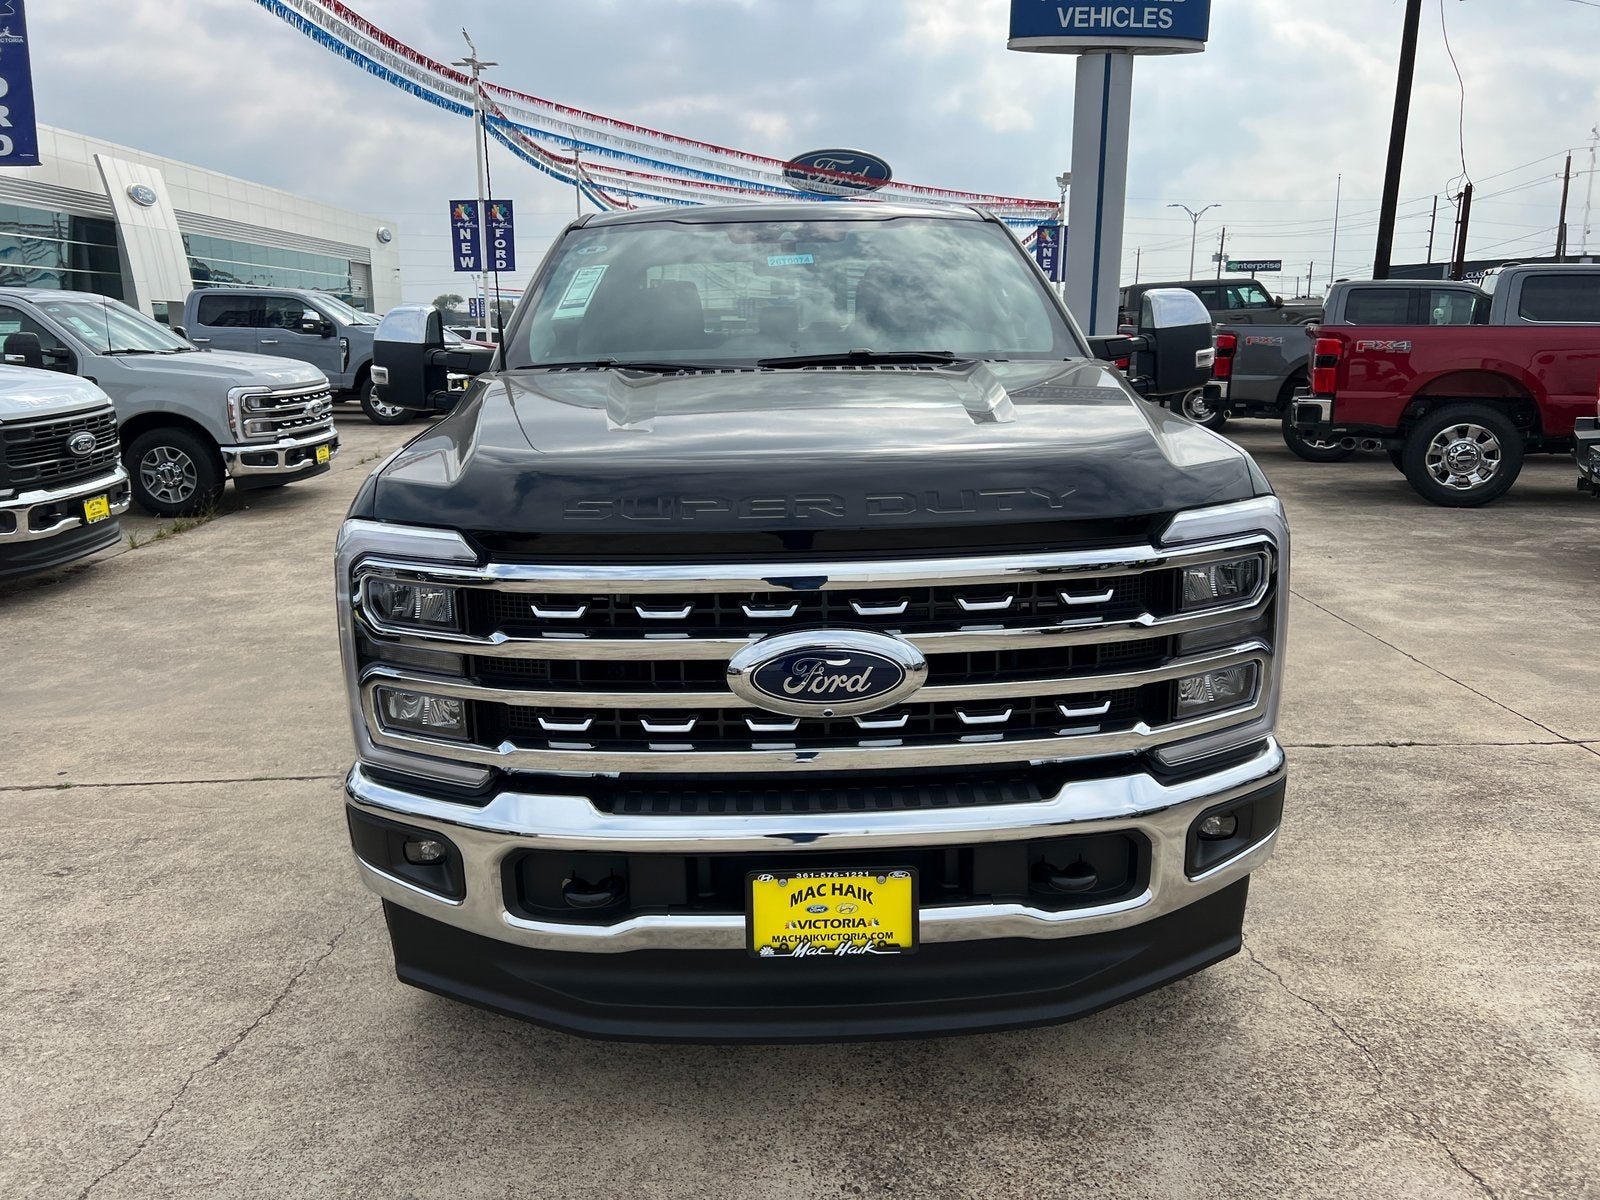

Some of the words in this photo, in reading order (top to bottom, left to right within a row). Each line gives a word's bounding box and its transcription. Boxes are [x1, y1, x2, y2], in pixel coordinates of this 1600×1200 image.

[1057, 6, 1173, 29] VEHICLES
[459, 228, 475, 268] NEW
[494, 228, 507, 269] FORD
[1227, 261, 1281, 271] enterprise
[1465, 270, 1486, 278] CLAS
[1245, 336, 1283, 345] FX4
[1356, 340, 1412, 353] FX4
[562, 494, 844, 520] SUPER
[865, 486, 1078, 516] DUTY
[783, 657, 874, 694] Ford
[796, 871, 870, 879] 361-576-1221
[790, 883, 827, 907] MAC
[831, 883, 874, 905] HAIK
[797, 917, 868, 930] VICTORIA
[771, 931, 894, 943] MACHAIKVICTORIA.COM
[790, 941, 833, 957] Mac
[834, 940, 877, 956] Haik
